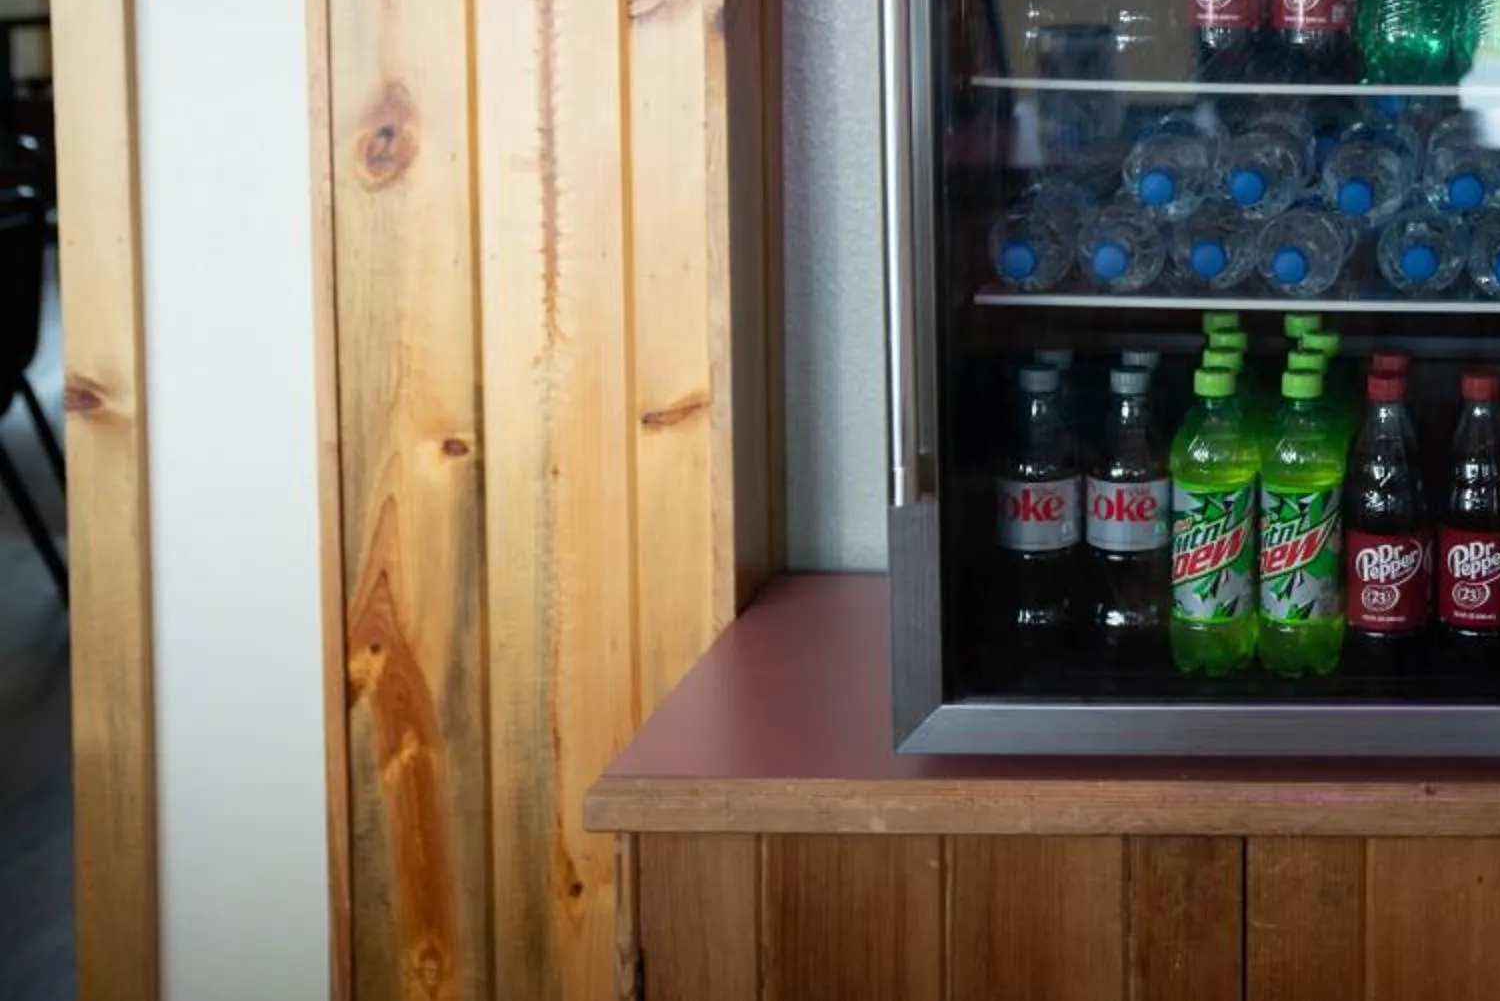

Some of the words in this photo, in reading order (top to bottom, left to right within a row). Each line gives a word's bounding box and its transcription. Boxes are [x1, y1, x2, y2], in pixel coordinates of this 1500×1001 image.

[998, 487, 1064, 523] oke
[1091, 487, 1158, 523] oke
[1359, 548, 1420, 583] Pepper
[1377, 544, 1404, 564] Dr
[1470, 541, 1496, 561] Dr
